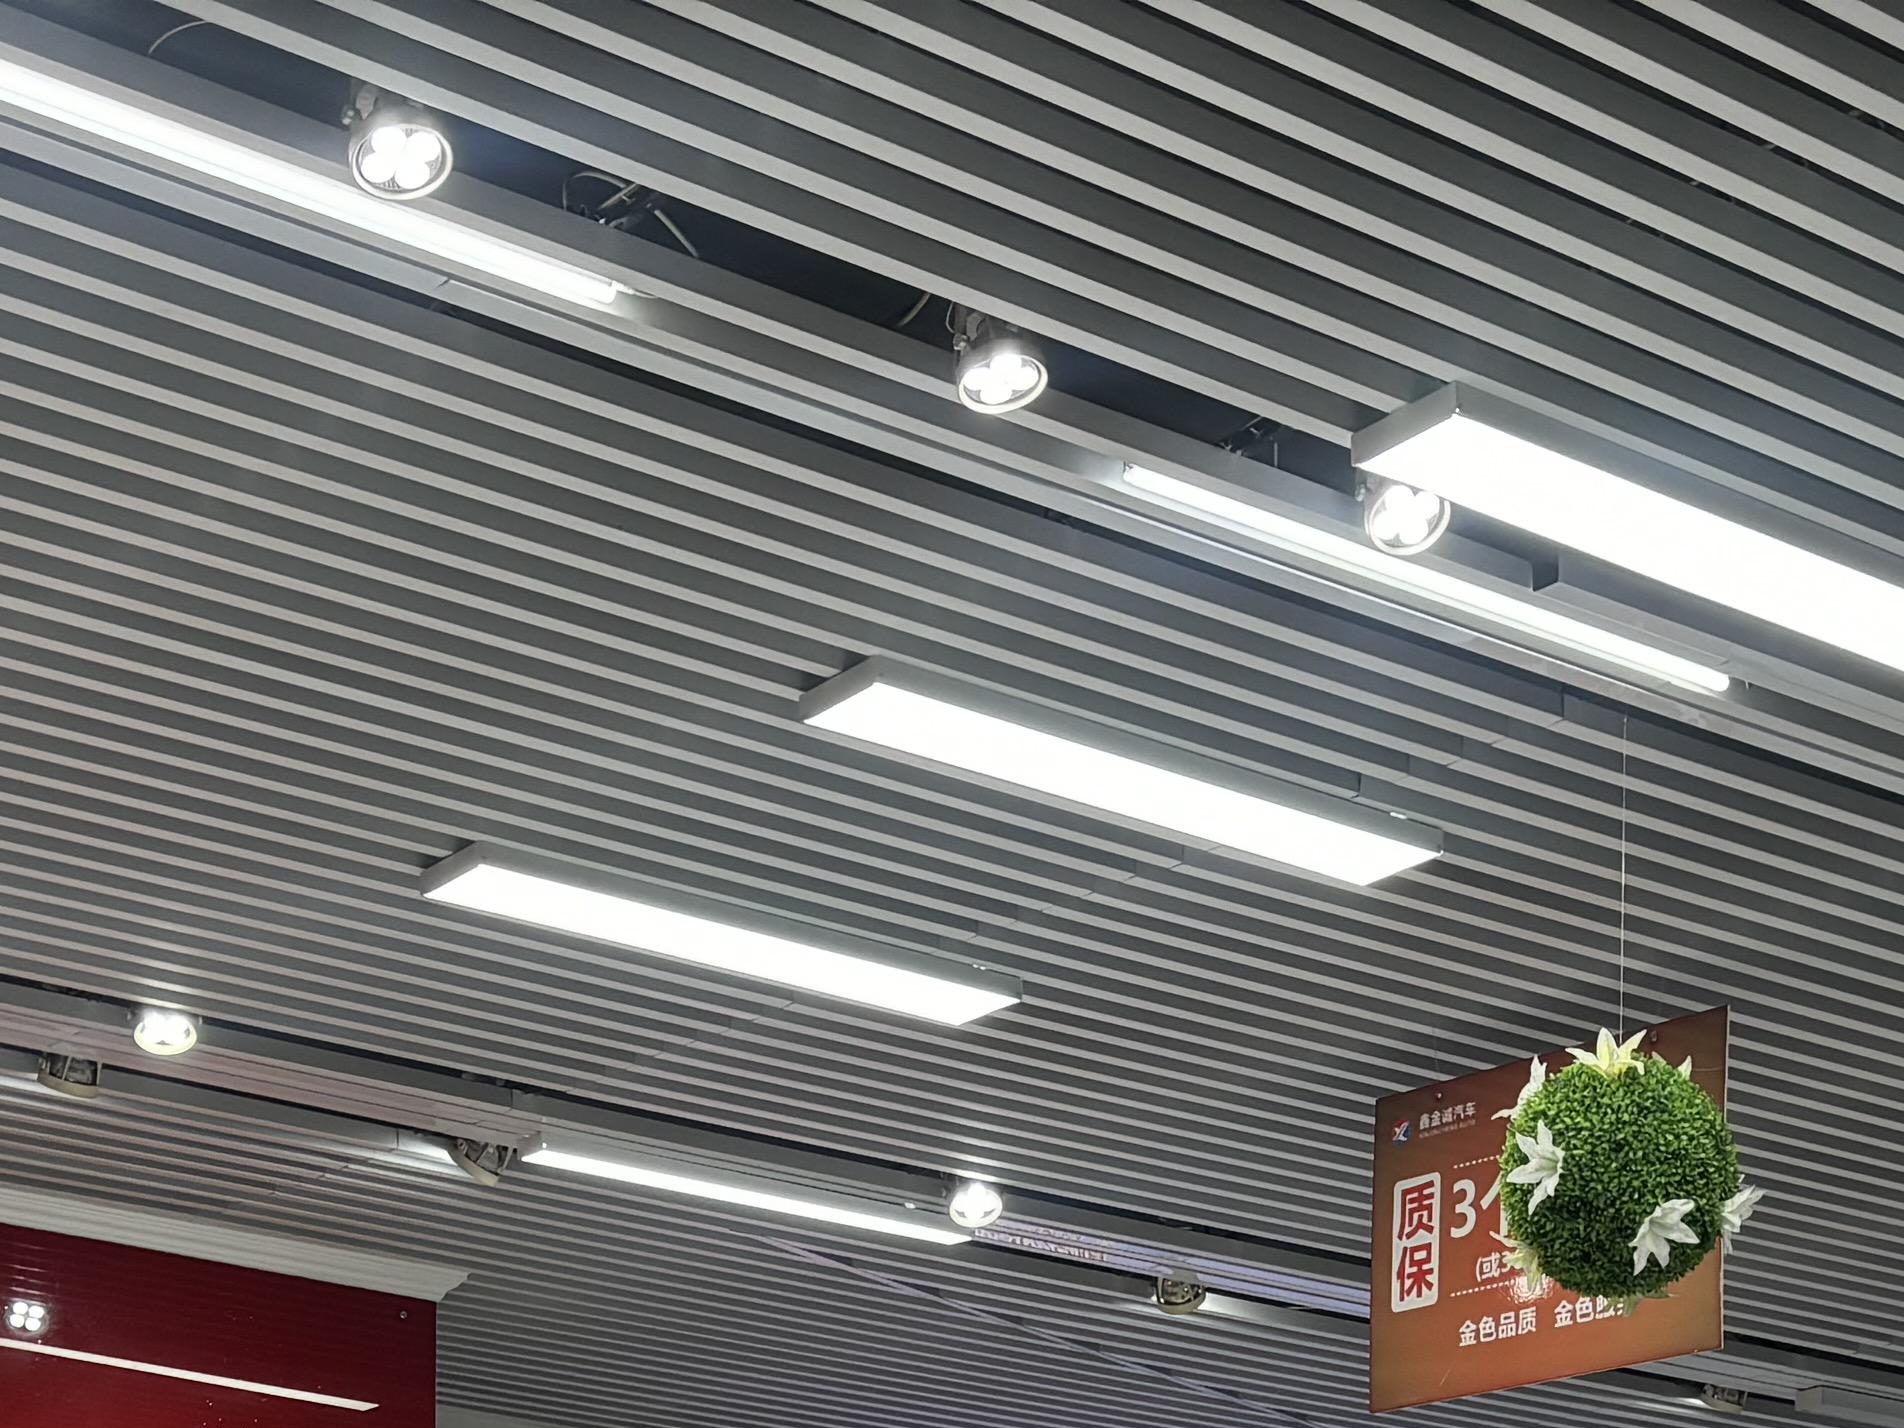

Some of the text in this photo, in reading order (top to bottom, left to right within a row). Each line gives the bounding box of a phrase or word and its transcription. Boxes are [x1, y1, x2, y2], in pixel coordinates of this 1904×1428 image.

[1396, 1181, 1436, 1302] 质保
[1458, 1306, 1537, 1347] 金色品质
